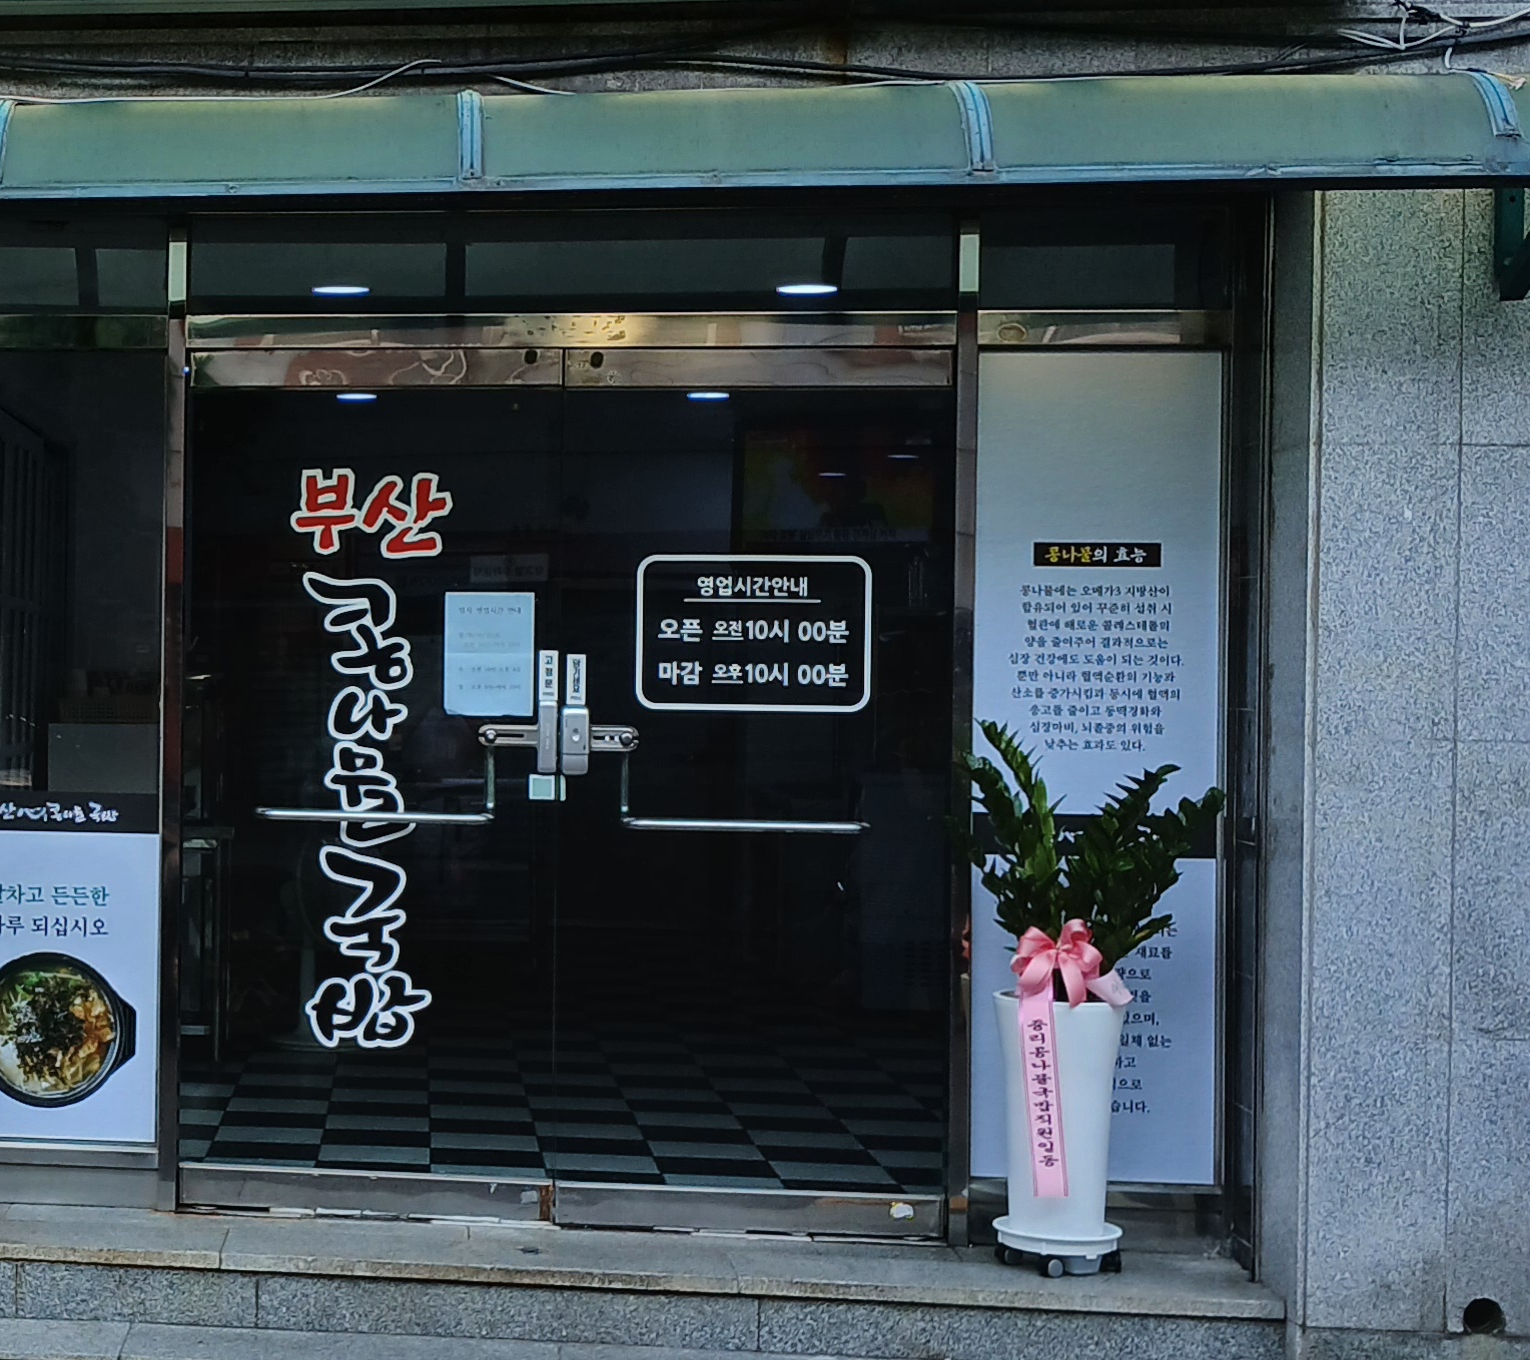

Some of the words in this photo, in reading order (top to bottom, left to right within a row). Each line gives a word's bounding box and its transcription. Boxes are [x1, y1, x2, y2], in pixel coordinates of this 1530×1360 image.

[290, 468, 453, 559] 부산
[1044, 546, 1108, 564] 콩나물의
[1113, 546, 1147, 564] 효능
[1020, 584, 1078, 597] 콩나물에는
[1080, 585, 1122, 597] 오메가3
[1124, 585, 1170, 598] 지방산이
[1160, 603, 1172, 615] 시
[657, 618, 704, 642] 오픈
[797, 620, 850, 644] 00분
[1008, 652, 1031, 665] 심장
[1034, 653, 1081, 665] 건강에도
[1083, 653, 1117, 666] 도움이
[1121, 654, 1144, 666] 되는
[1147, 654, 1184, 667] 것이다.
[657, 661, 703, 685] 마감
[797, 663, 849, 687] 00분
[1042, 670, 1077, 683] 아니라
[1066, 704, 1101, 717] 줄이고
[1081, 738, 1117, 752] 효과도
[1120, 739, 1146, 752] 있다.
[50, 885, 111, 907] 든든한
[31, 915, 110, 937] 되십시오
